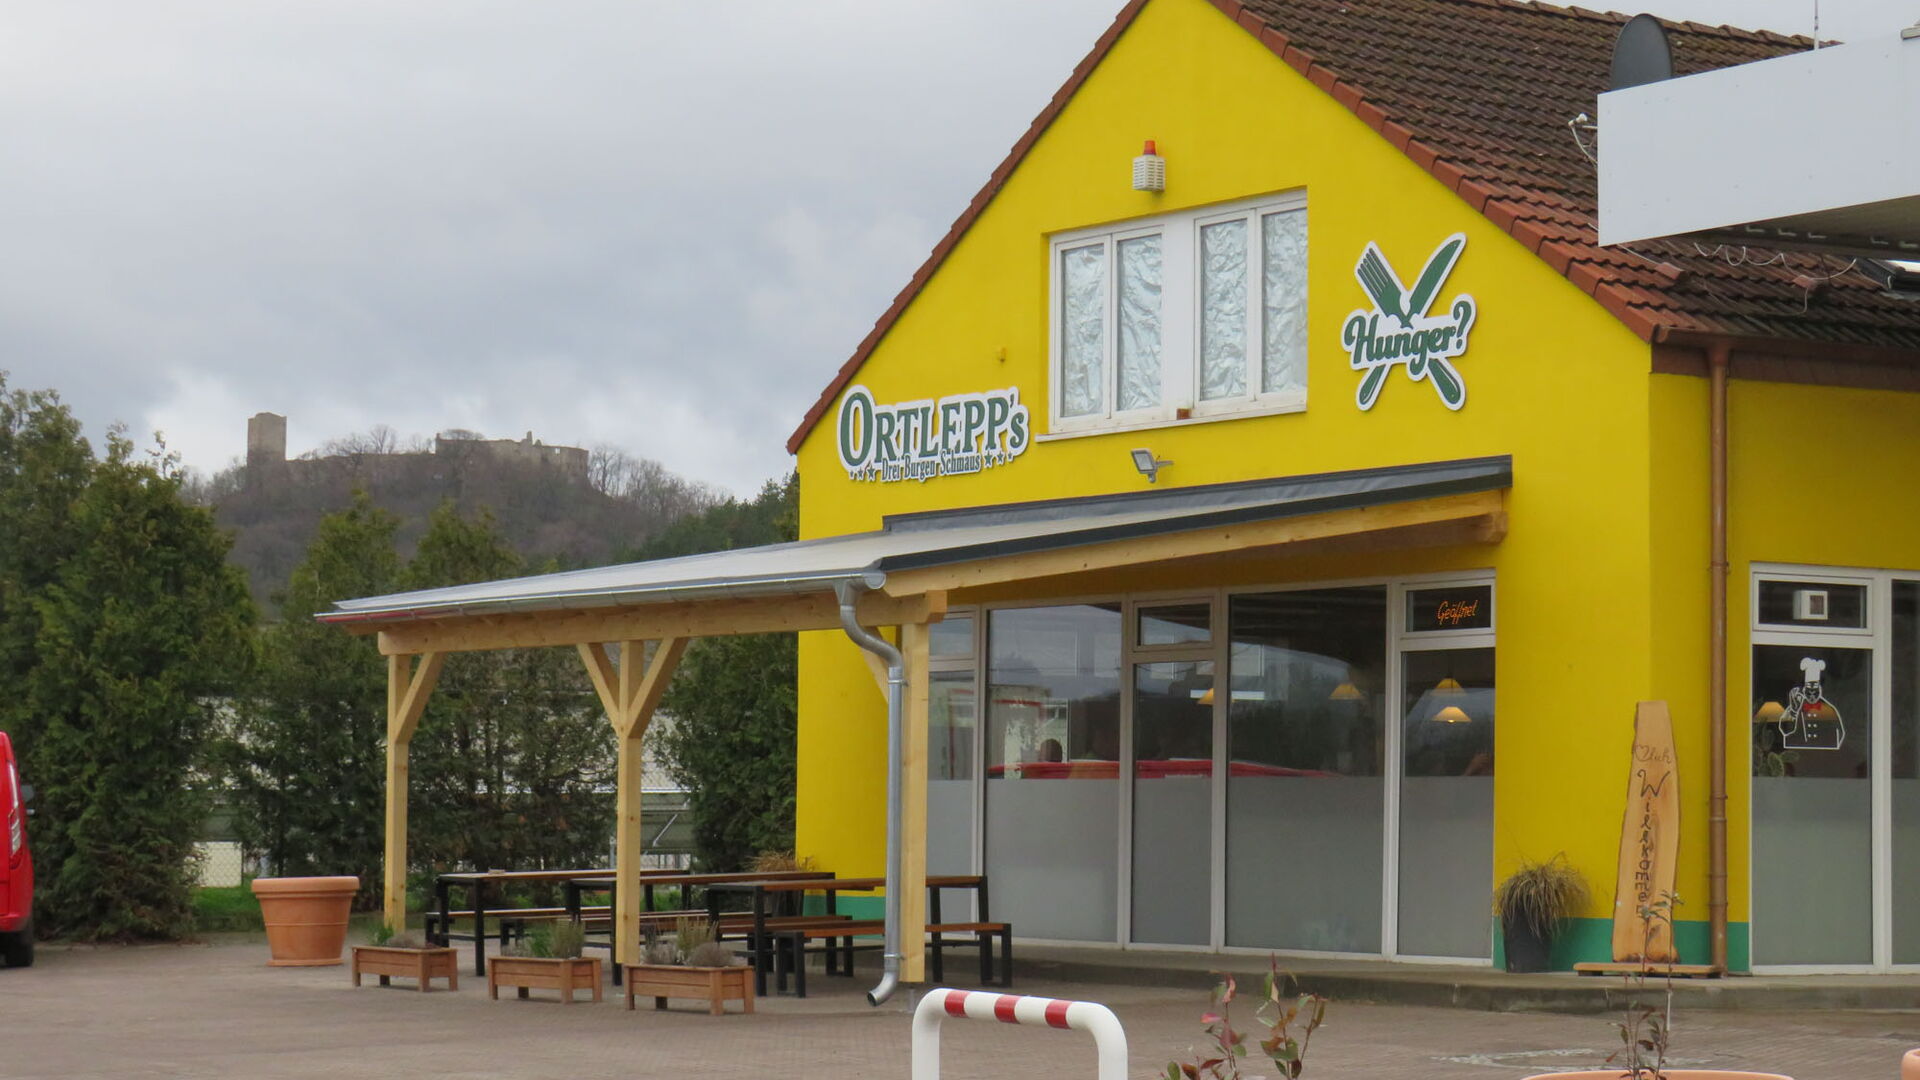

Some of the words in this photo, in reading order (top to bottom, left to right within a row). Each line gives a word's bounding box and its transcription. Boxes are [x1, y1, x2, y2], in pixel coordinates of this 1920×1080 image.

[1344, 300, 1472, 375] Hunger?
[882, 458, 900, 480] Drei
[904, 454, 935, 480] Burgen
[940, 450, 980, 474] Schmaus
